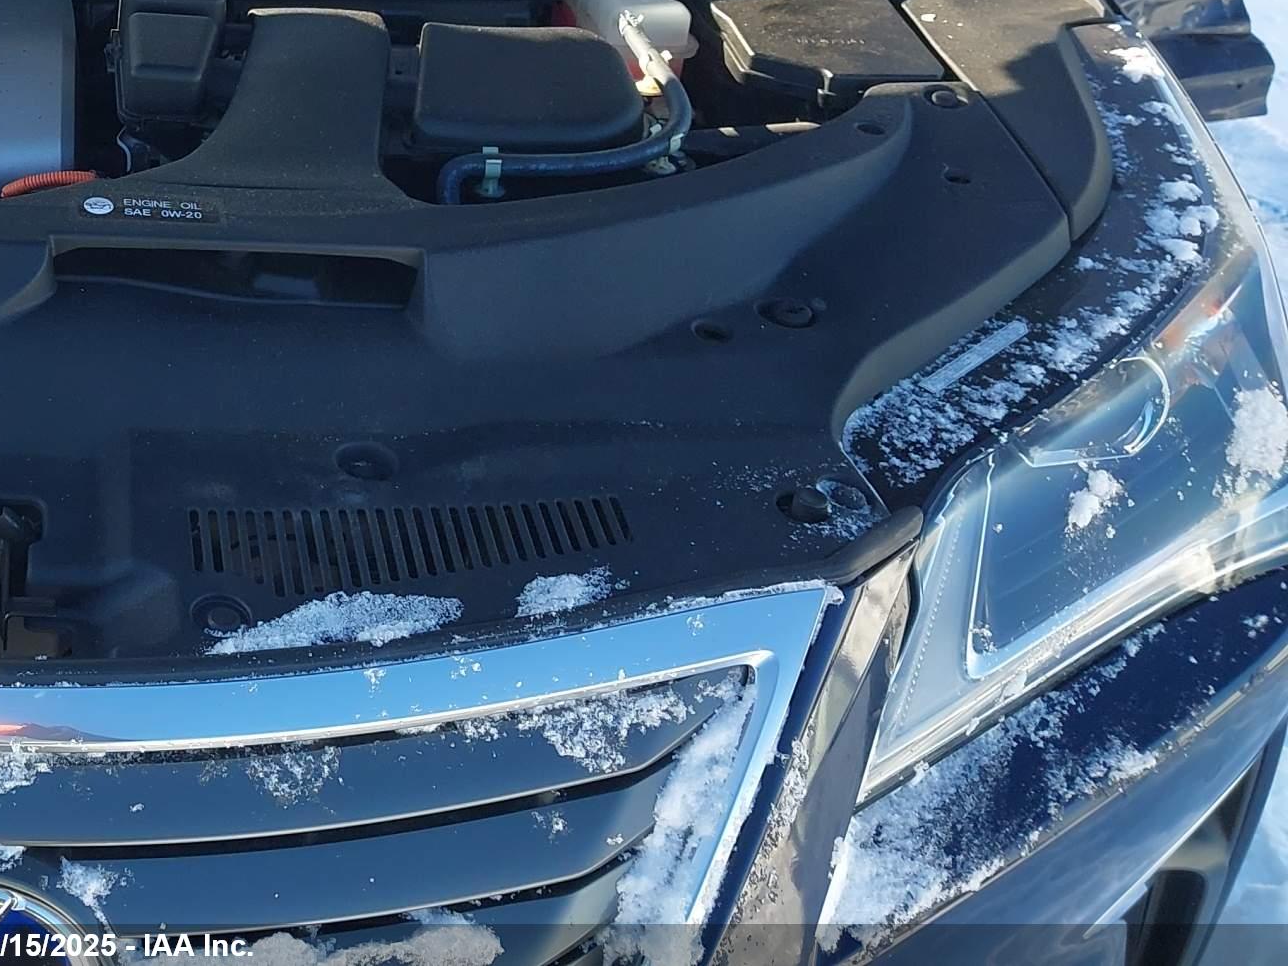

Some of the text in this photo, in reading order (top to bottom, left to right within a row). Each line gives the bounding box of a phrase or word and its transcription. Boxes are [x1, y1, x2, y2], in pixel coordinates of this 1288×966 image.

[123, 198, 201, 210] ENGINE OIL
[124, 208, 202, 219] SAE 0W-20
